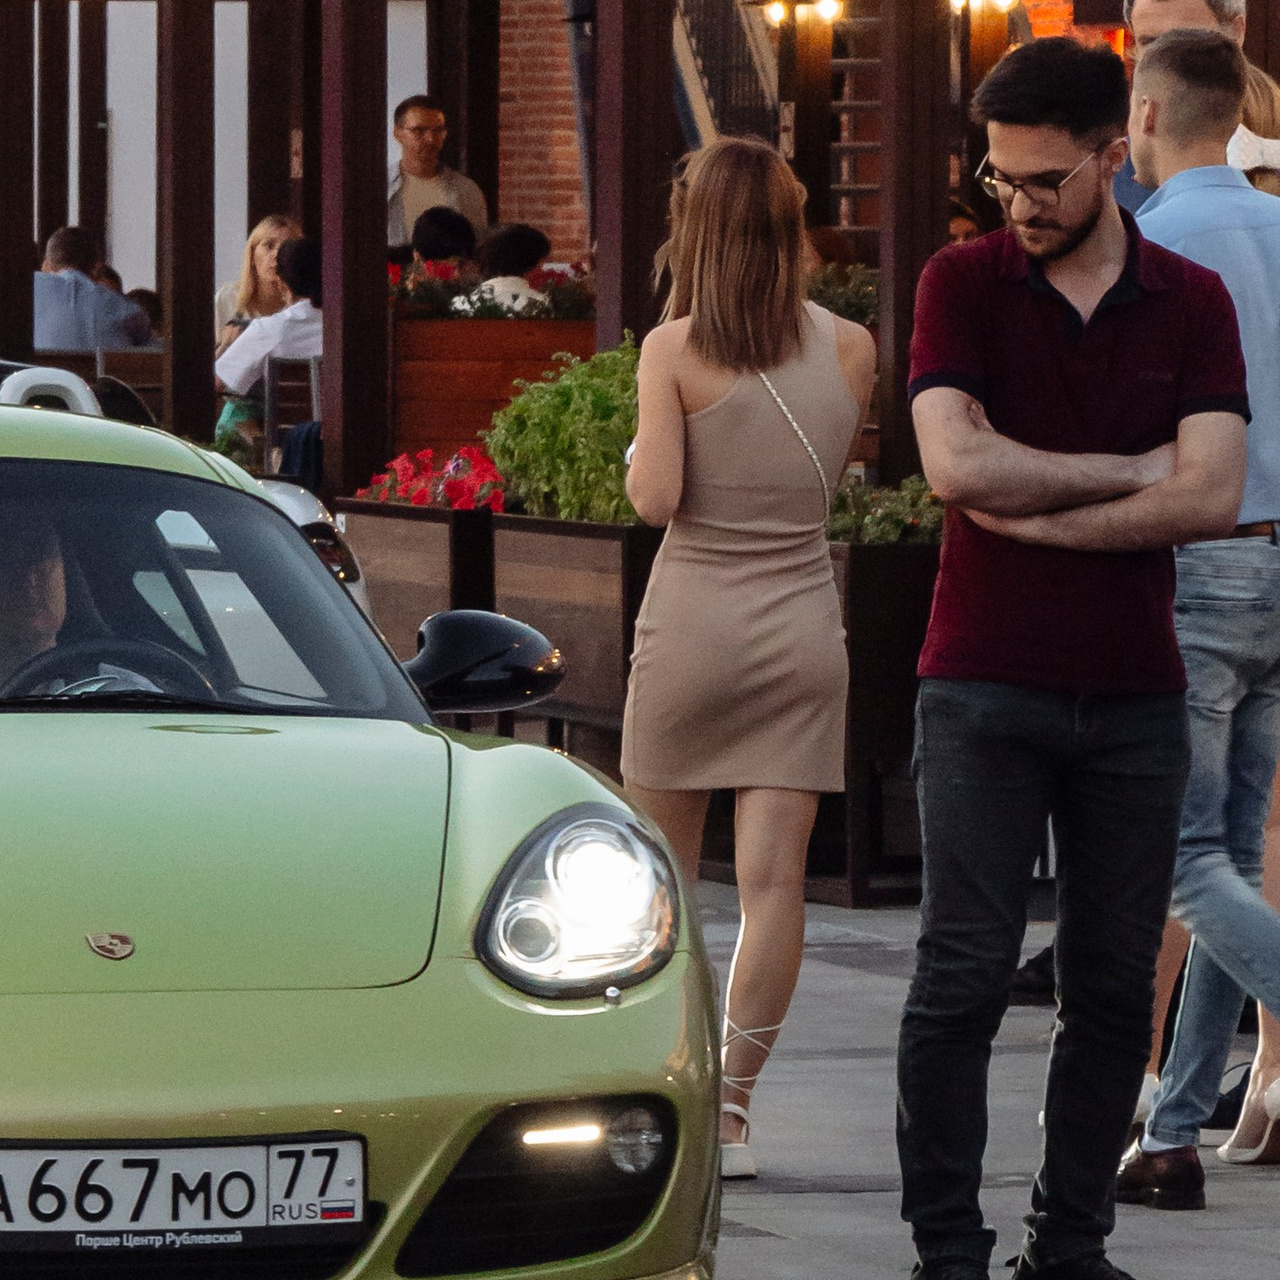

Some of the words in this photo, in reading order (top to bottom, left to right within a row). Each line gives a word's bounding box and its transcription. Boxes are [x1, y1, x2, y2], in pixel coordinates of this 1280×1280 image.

[277, 1147, 339, 1200] 77
[272, 1203, 318, 1221] RUS
[75, 1233, 121, 1249] Порше
[123, 1233, 163, 1248] Центр
